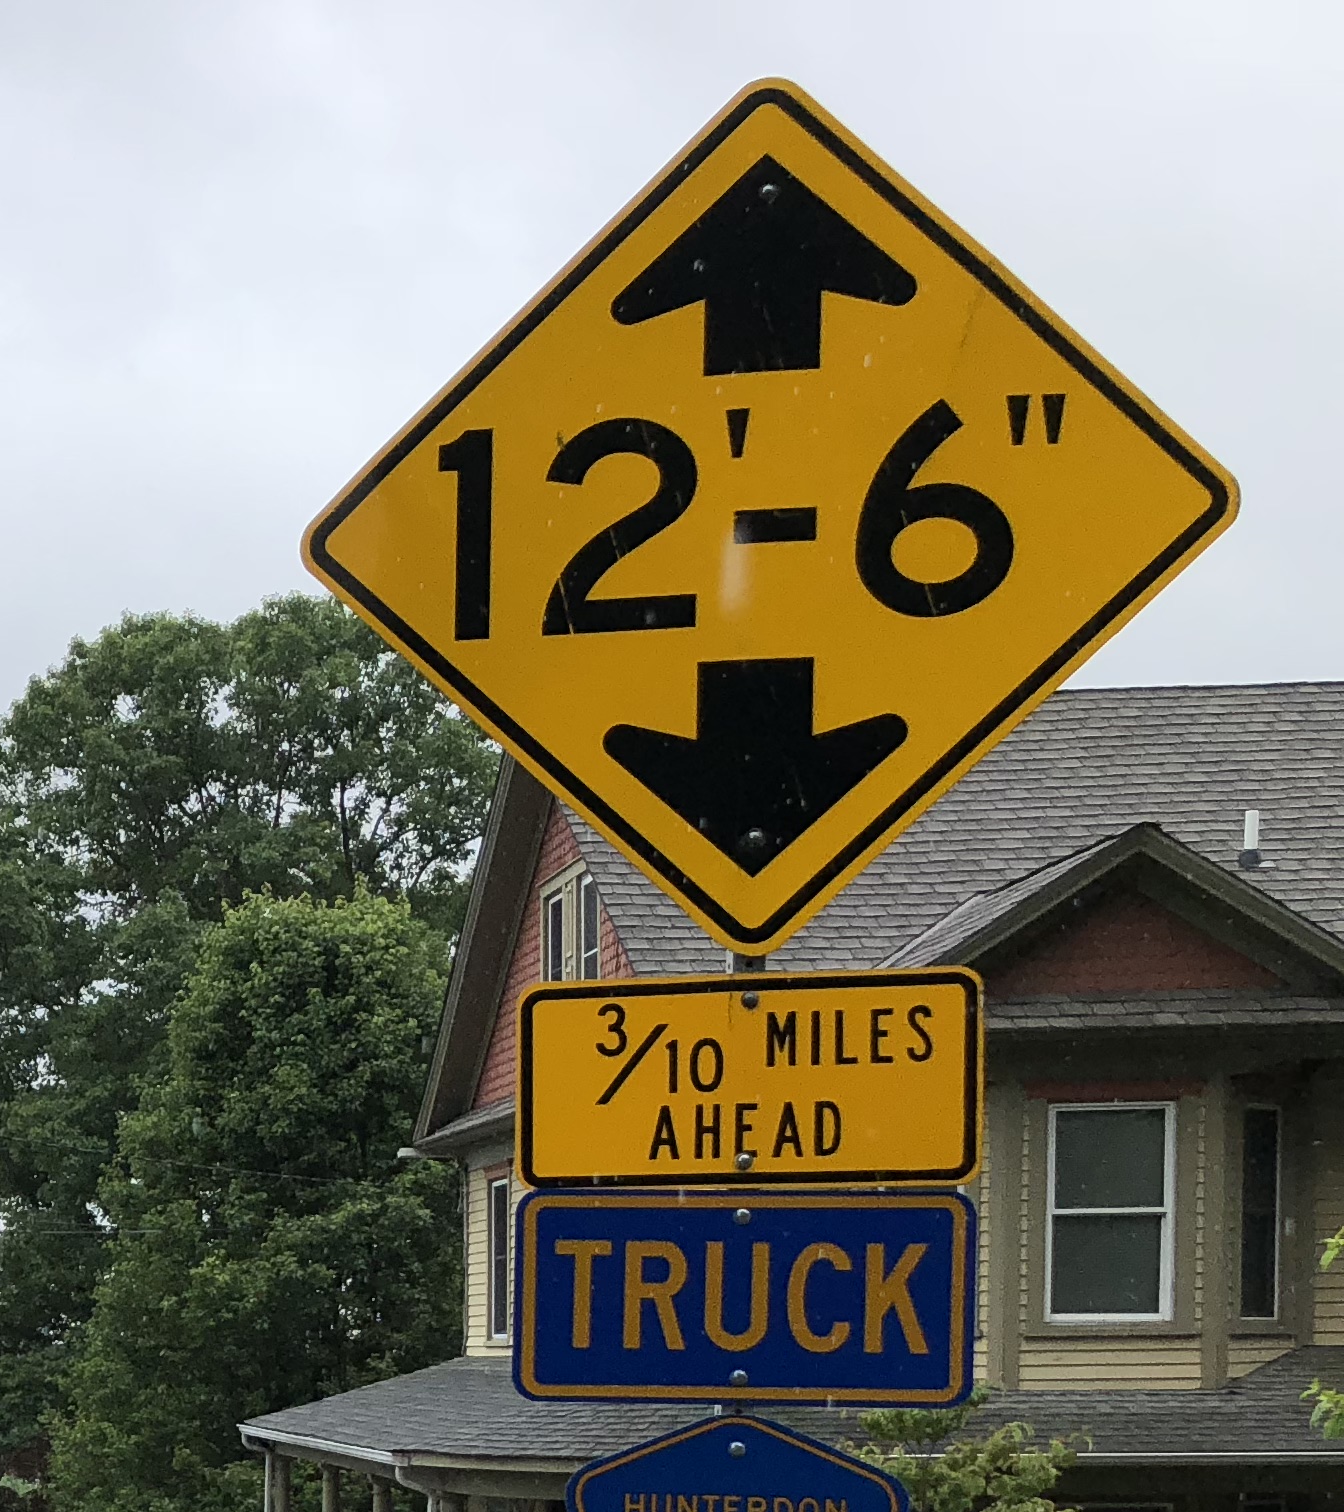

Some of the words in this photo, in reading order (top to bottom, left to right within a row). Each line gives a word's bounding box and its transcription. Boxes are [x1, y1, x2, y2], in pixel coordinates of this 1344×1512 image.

[436, 392, 1067, 642] 12'-6"
[595, 1002, 724, 1106] 3/10
[765, 1004, 934, 1068] MILES
[647, 1100, 843, 1161] AHEAD
[553, 1238, 931, 1355] TRUCK
